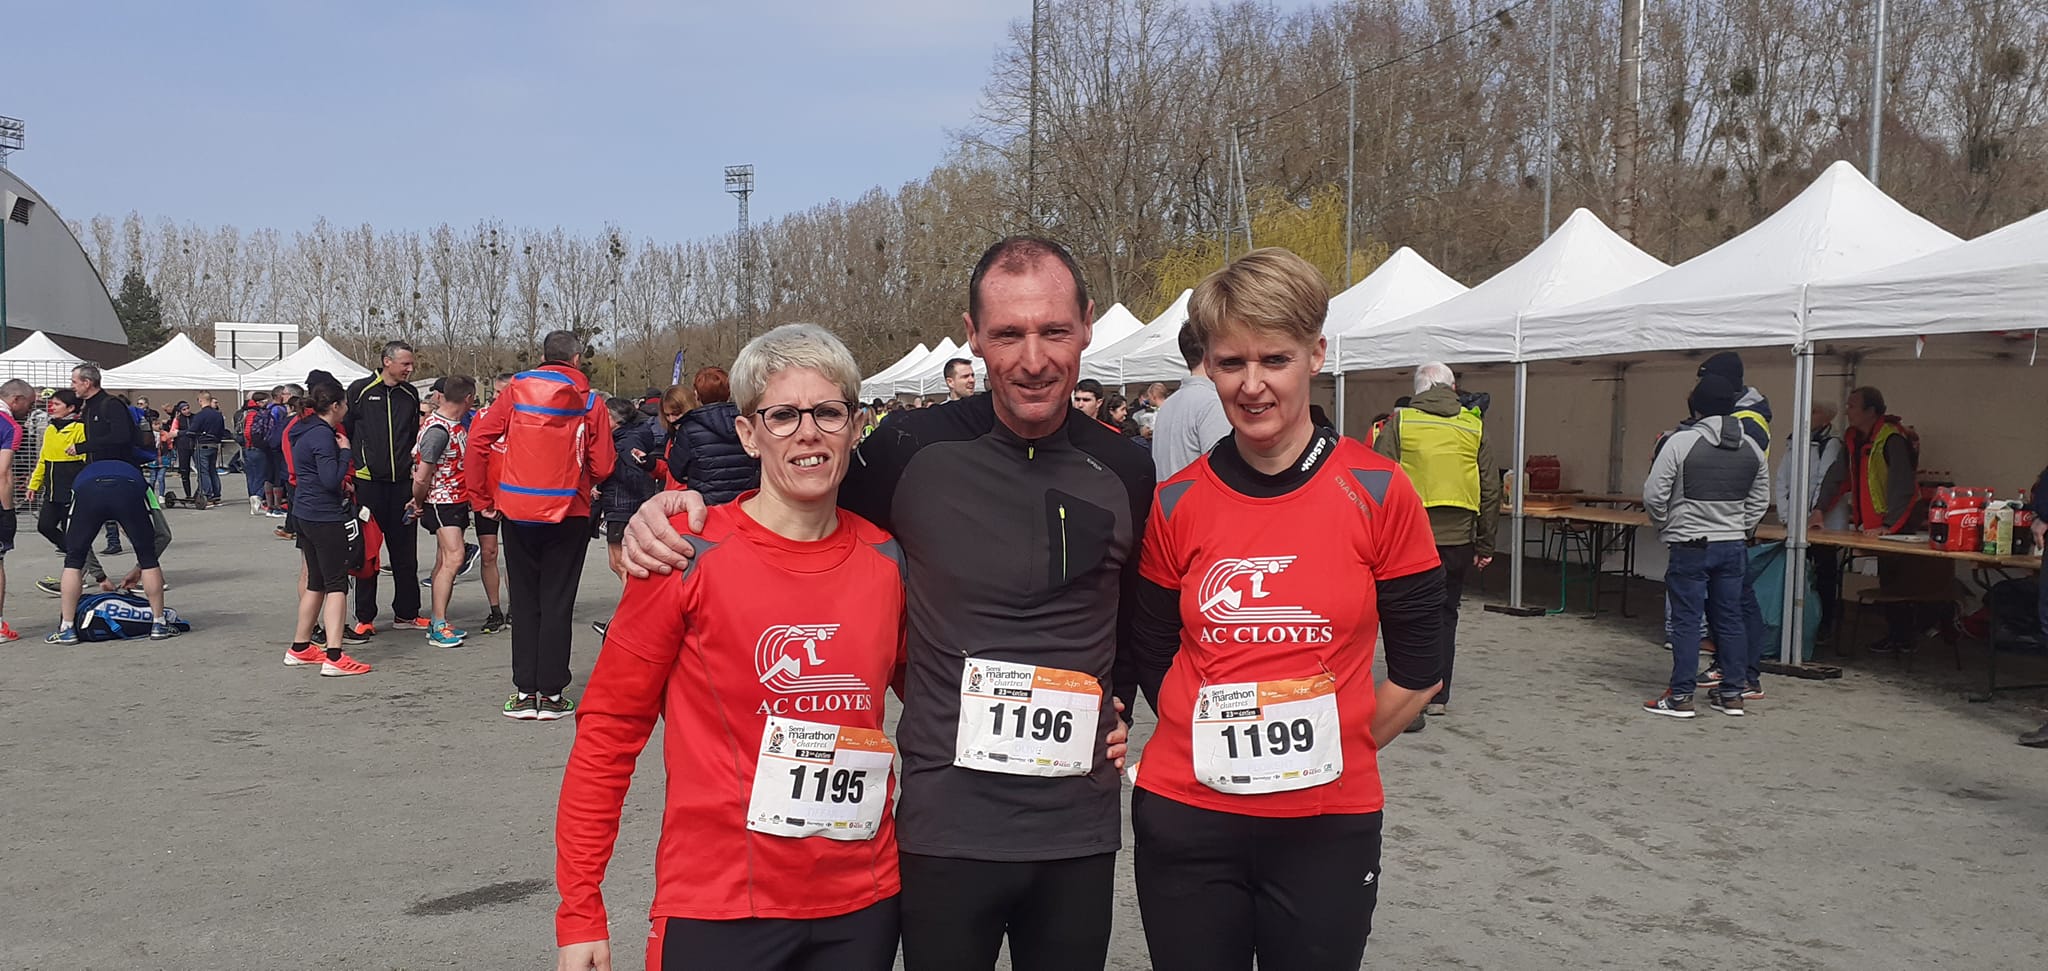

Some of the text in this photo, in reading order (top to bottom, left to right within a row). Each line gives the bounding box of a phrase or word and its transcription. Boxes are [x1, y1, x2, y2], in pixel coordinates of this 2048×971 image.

[1200, 626, 1333, 644] AC CLOYES
[986, 670, 1032, 680] marathon
[994, 679, 1024, 687] chartres
[1212, 690, 1255, 703] marathon
[756, 694, 872, 716] AC CLOYES
[788, 725, 805, 733] Semi
[989, 703, 1074, 744] 1196
[788, 731, 836, 741] marathon
[1221, 719, 1314, 759] 1199
[796, 740, 827, 749] chartres
[789, 765, 867, 804] 1195
